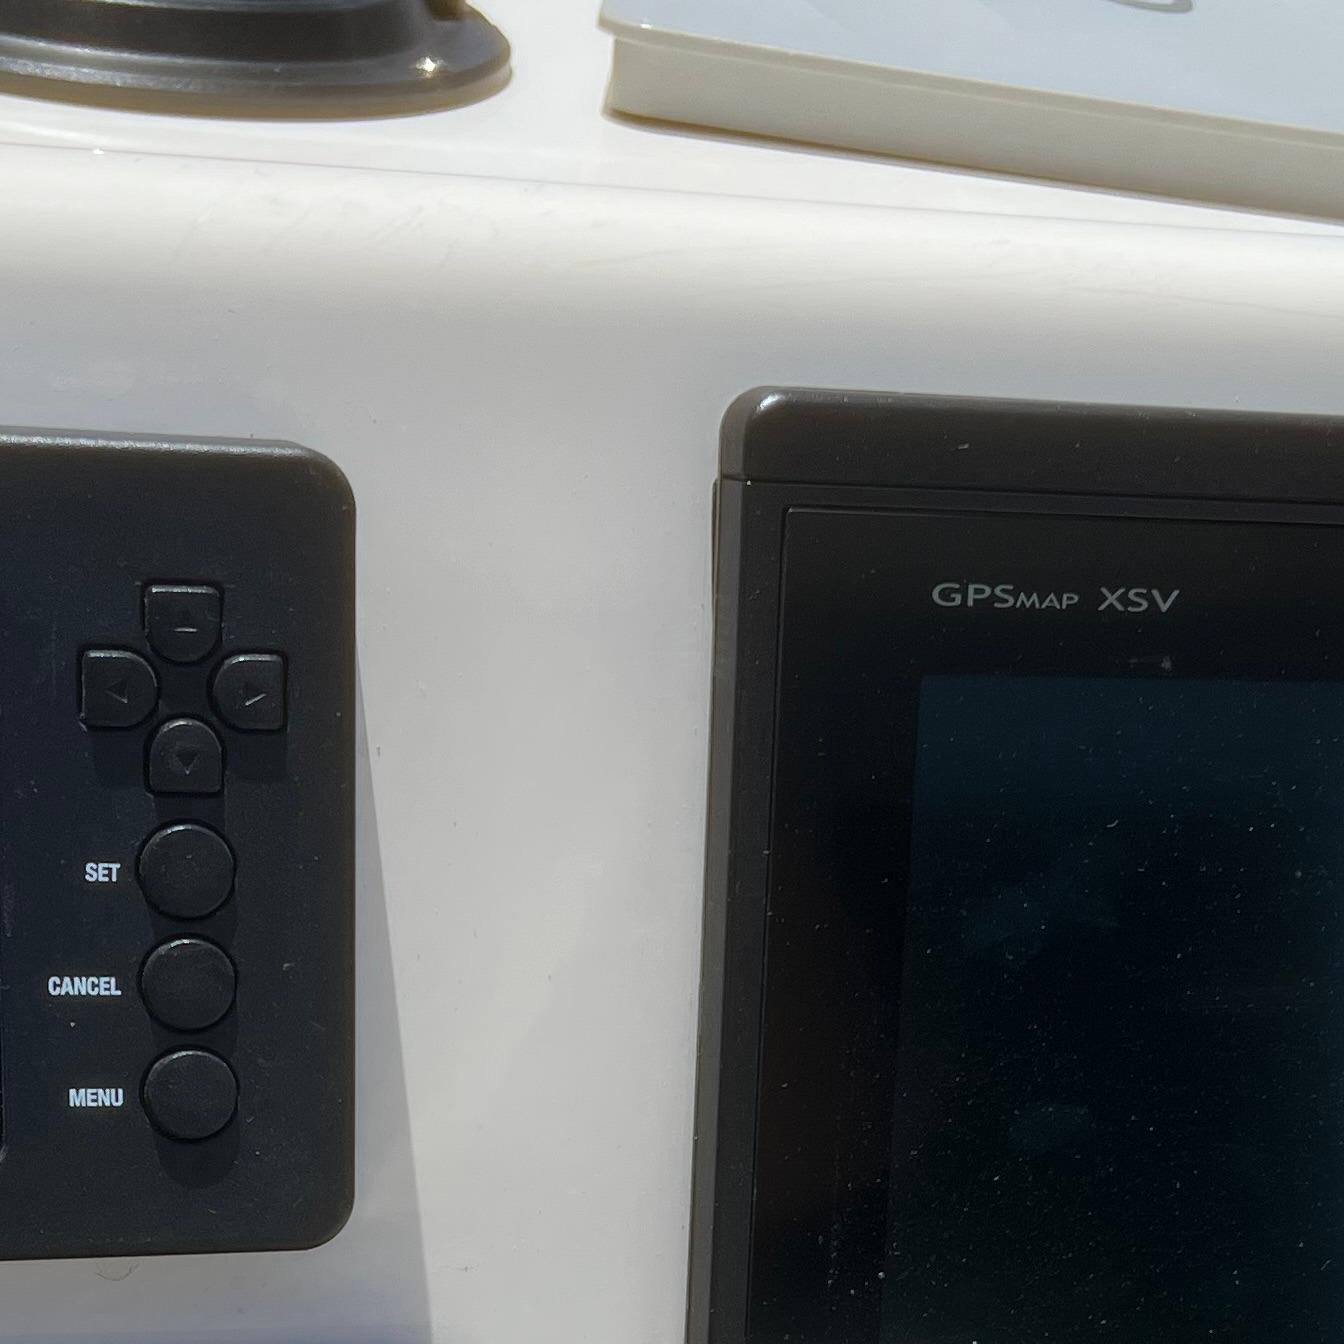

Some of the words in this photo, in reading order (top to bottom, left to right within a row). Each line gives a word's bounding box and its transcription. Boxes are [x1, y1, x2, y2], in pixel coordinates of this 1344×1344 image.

[1097, 587, 1180, 613] XSV
[84, 863, 121, 883] SET
[47, 975, 122, 997] CANCEL
[68, 1088, 124, 1108] MENU
